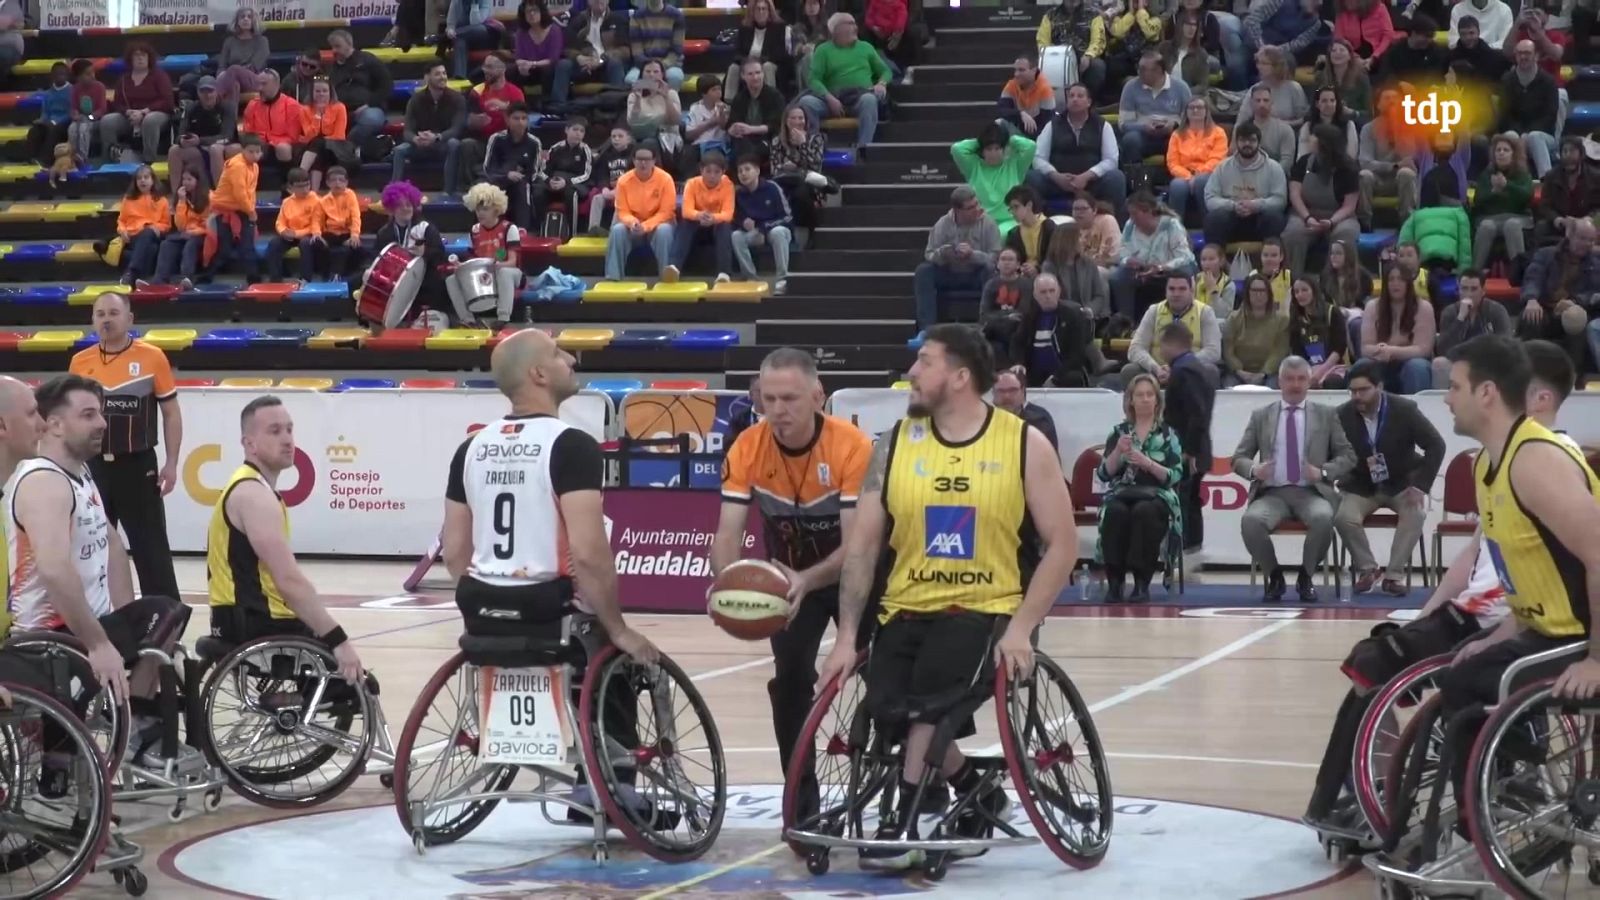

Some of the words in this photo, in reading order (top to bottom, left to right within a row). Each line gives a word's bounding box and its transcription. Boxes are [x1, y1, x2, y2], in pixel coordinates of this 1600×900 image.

[475, 443, 542, 461] gaviota
[329, 469, 381, 483] Consejo
[694, 463, 718, 474] DEL
[330, 483, 384, 497] Superior
[934, 476, 970, 492] 35
[329, 498, 346, 510] de
[348, 498, 406, 512] Deportes
[493, 491, 516, 560] 9
[619, 527, 714, 548] Ayuntamien
[925, 532, 966, 555] AXA
[615, 549, 715, 576] Guadalaj
[907, 567, 993, 585] ILUNION
[492, 673, 551, 693] ZARZUELA
[509, 695, 536, 726] 09
[487, 741, 558, 757] gaviota
